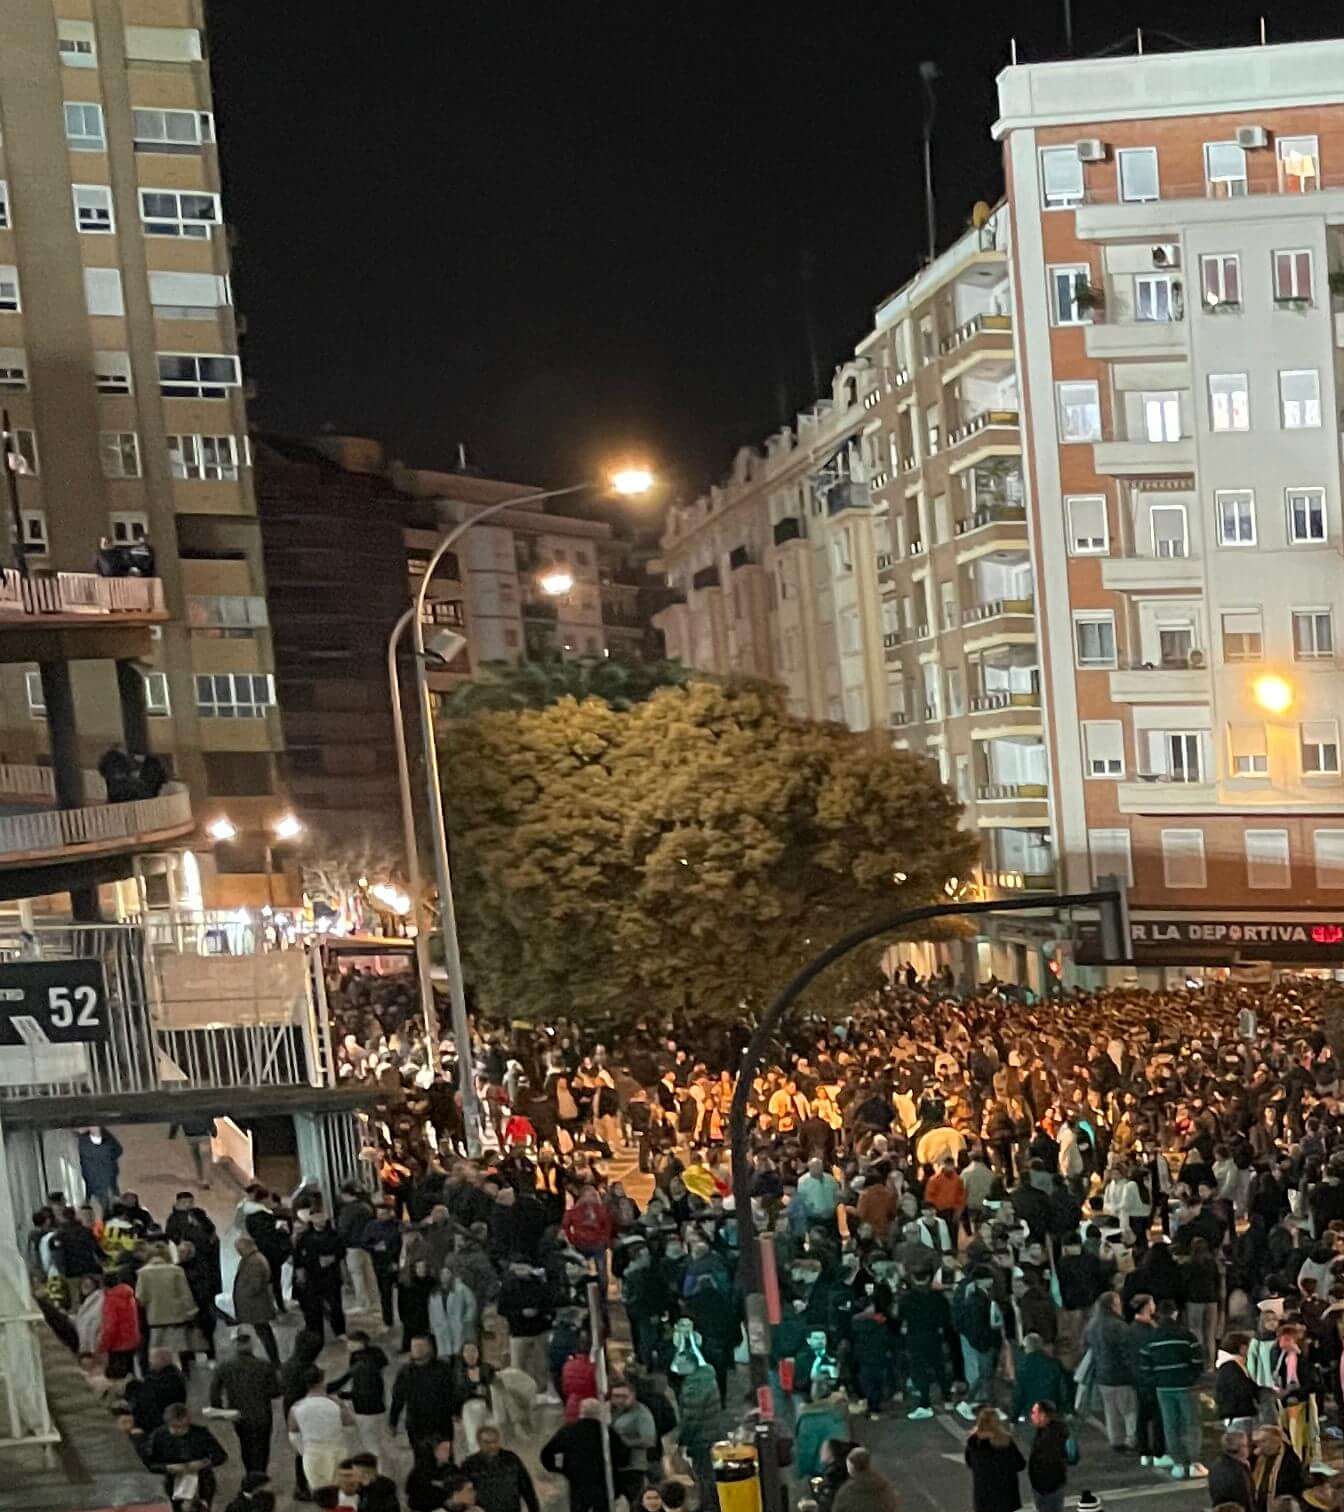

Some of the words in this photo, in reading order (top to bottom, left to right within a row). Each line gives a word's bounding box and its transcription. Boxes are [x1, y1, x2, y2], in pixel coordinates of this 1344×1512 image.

[1152, 924, 1181, 940] LA
[1188, 925, 1307, 941] DEPORTIVA
[48, 985, 100, 1028] 52
